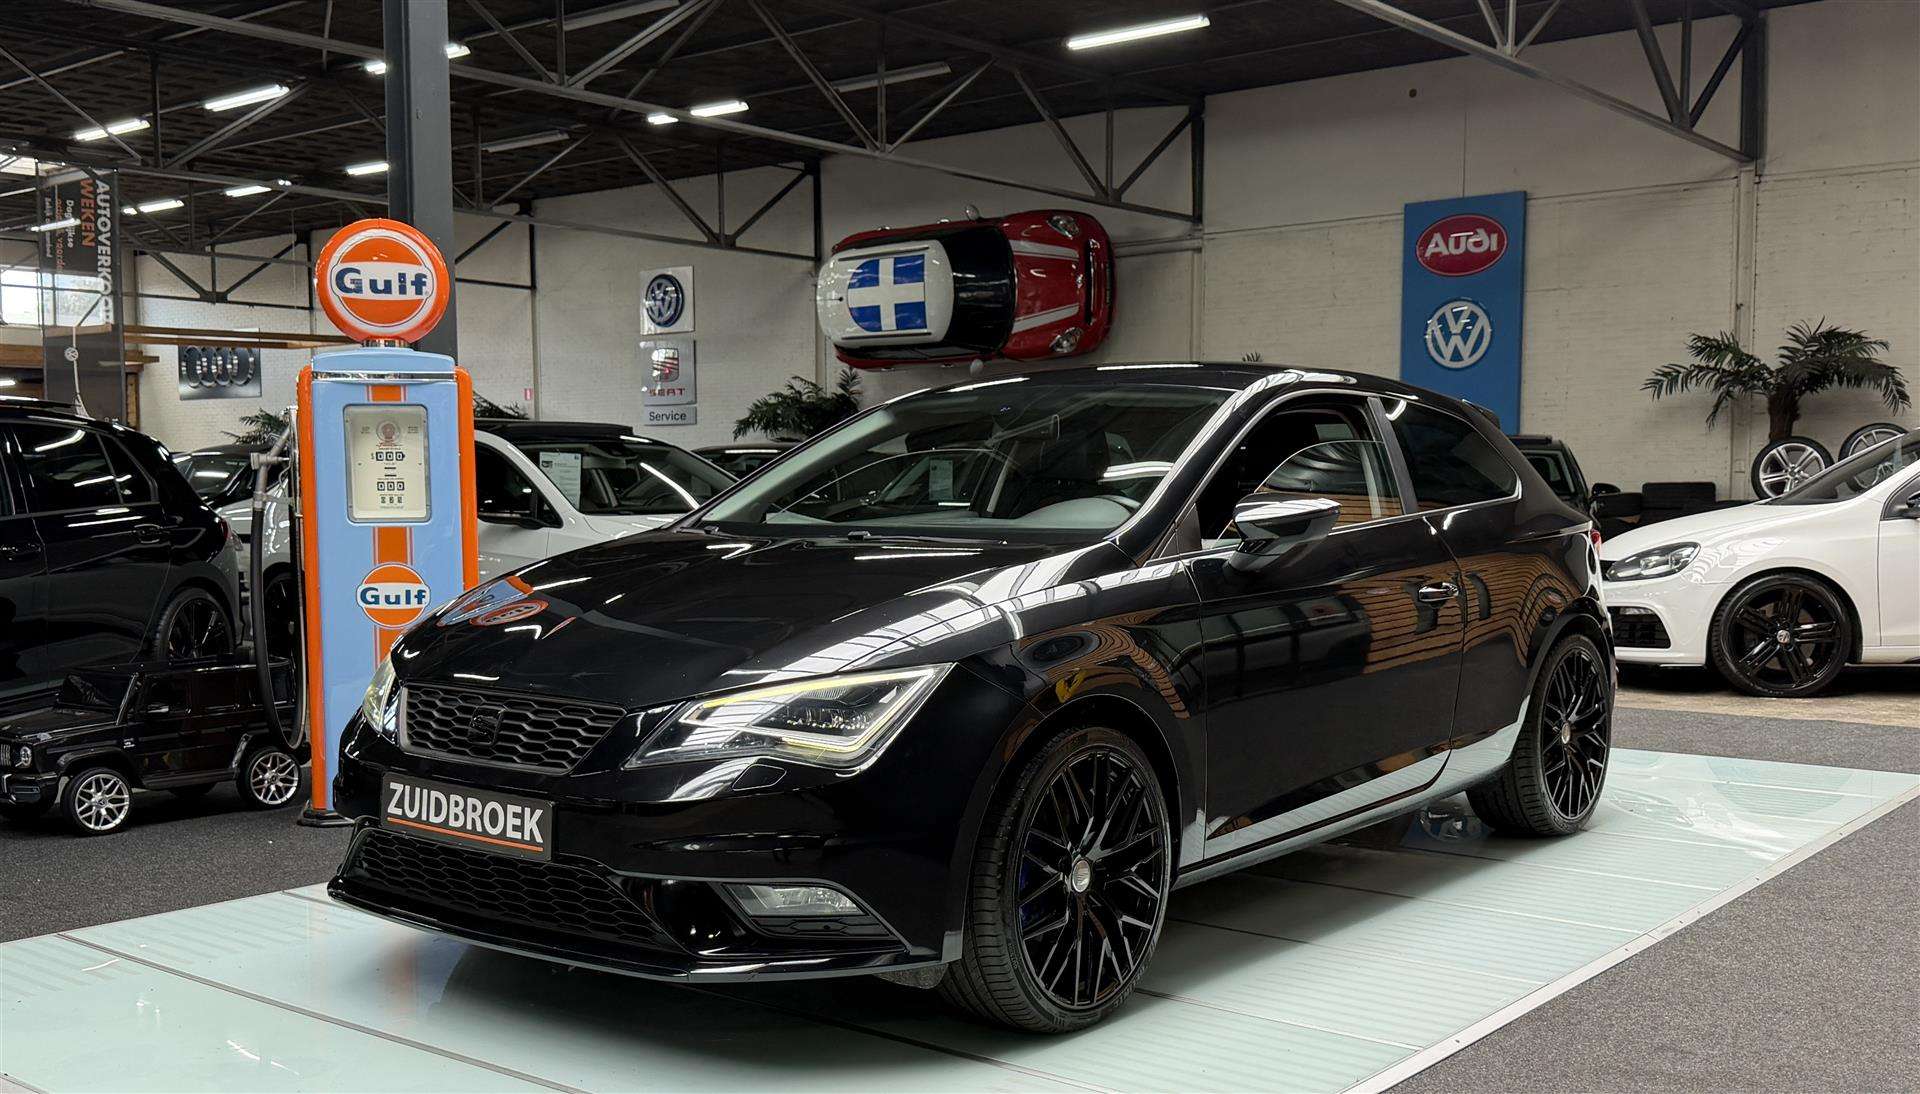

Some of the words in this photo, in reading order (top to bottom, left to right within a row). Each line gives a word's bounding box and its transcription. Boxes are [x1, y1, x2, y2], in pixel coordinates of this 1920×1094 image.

[79, 179, 96, 248] WEKEN
[335, 267, 428, 296] Gulf
[649, 388, 685, 397] SEAT
[649, 411, 687, 422] Service
[360, 587, 427, 605] Gulf
[387, 782, 544, 843] ZUIDBROEK
